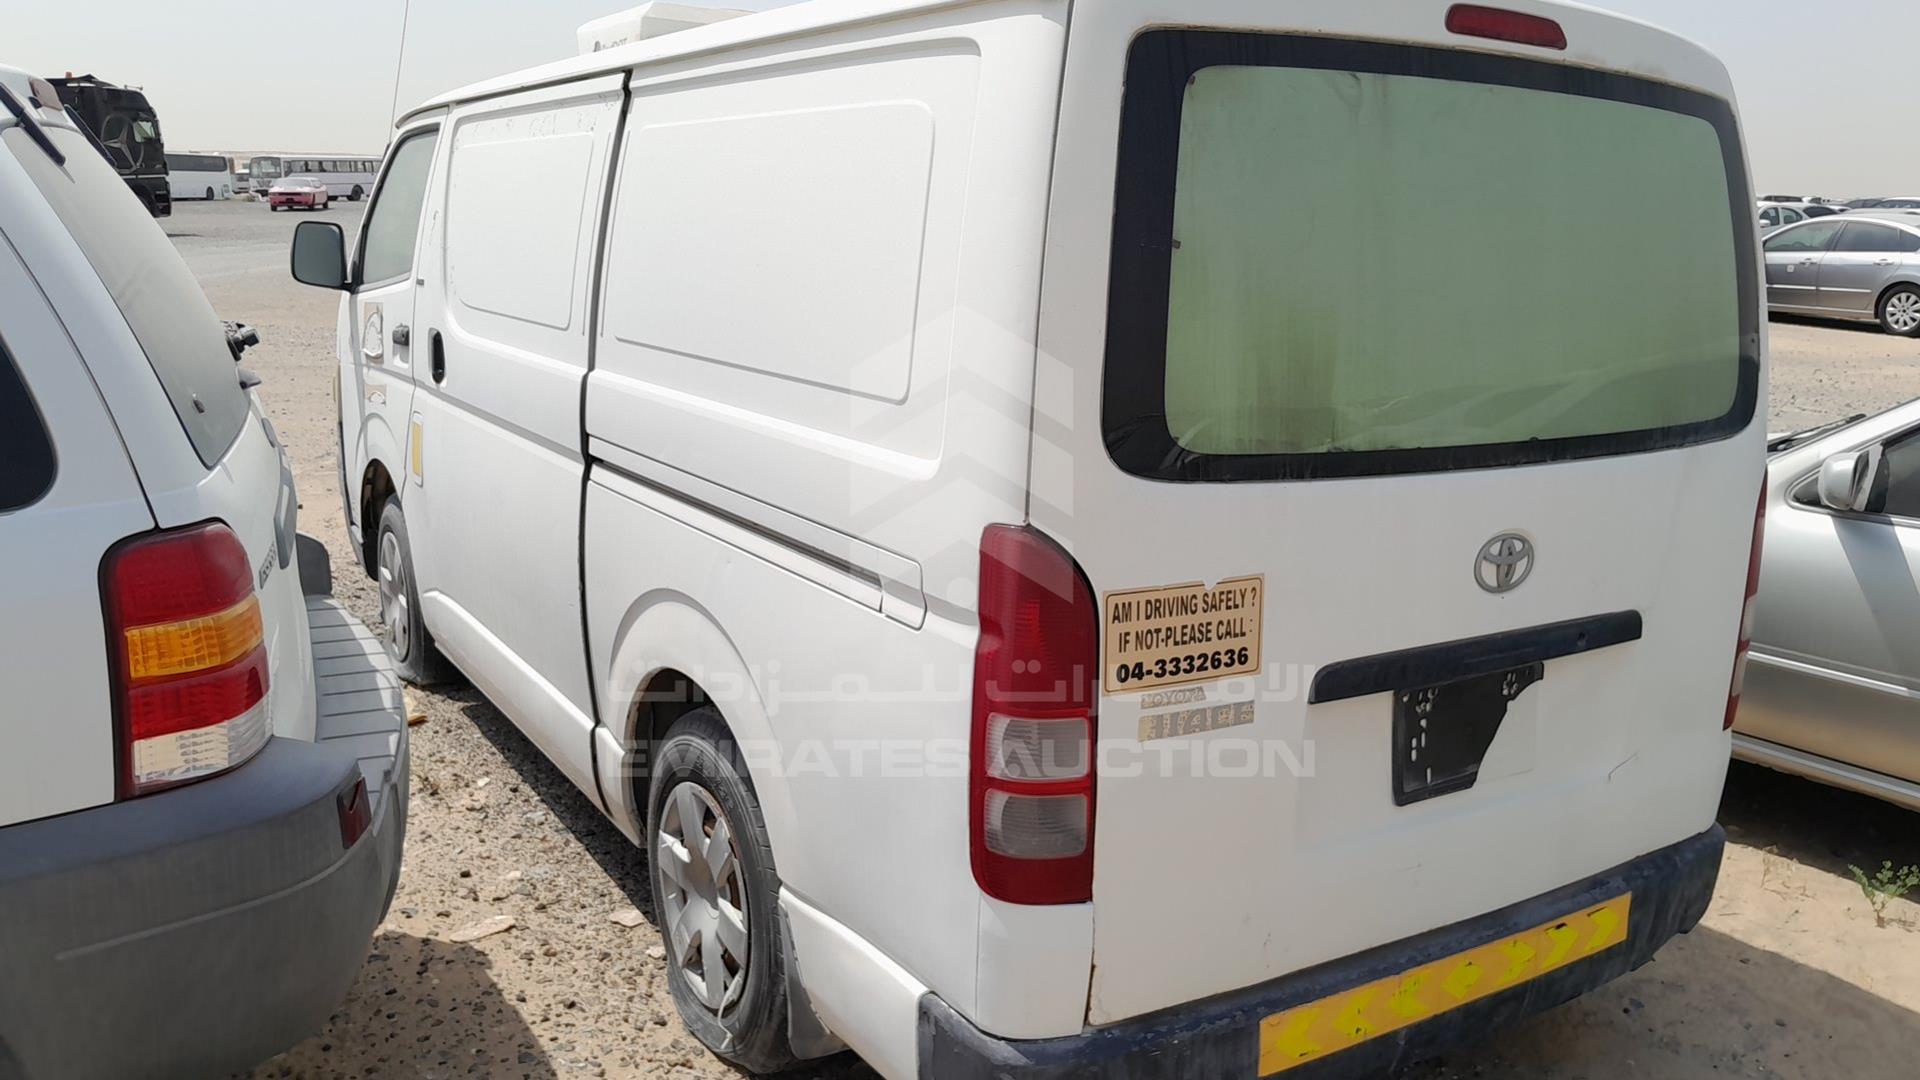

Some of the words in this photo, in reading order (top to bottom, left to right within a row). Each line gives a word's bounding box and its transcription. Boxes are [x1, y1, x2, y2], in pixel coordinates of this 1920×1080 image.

[1112, 601, 1132, 624] AM
[1136, 600, 1141, 622] I
[1144, 594, 1199, 621] DRIVING
[1202, 587, 1248, 614] SAFELY
[1118, 631, 1131, 654] IF
[1216, 617, 1247, 641] CALL
[1116, 646, 1249, 684] 04-3332636
